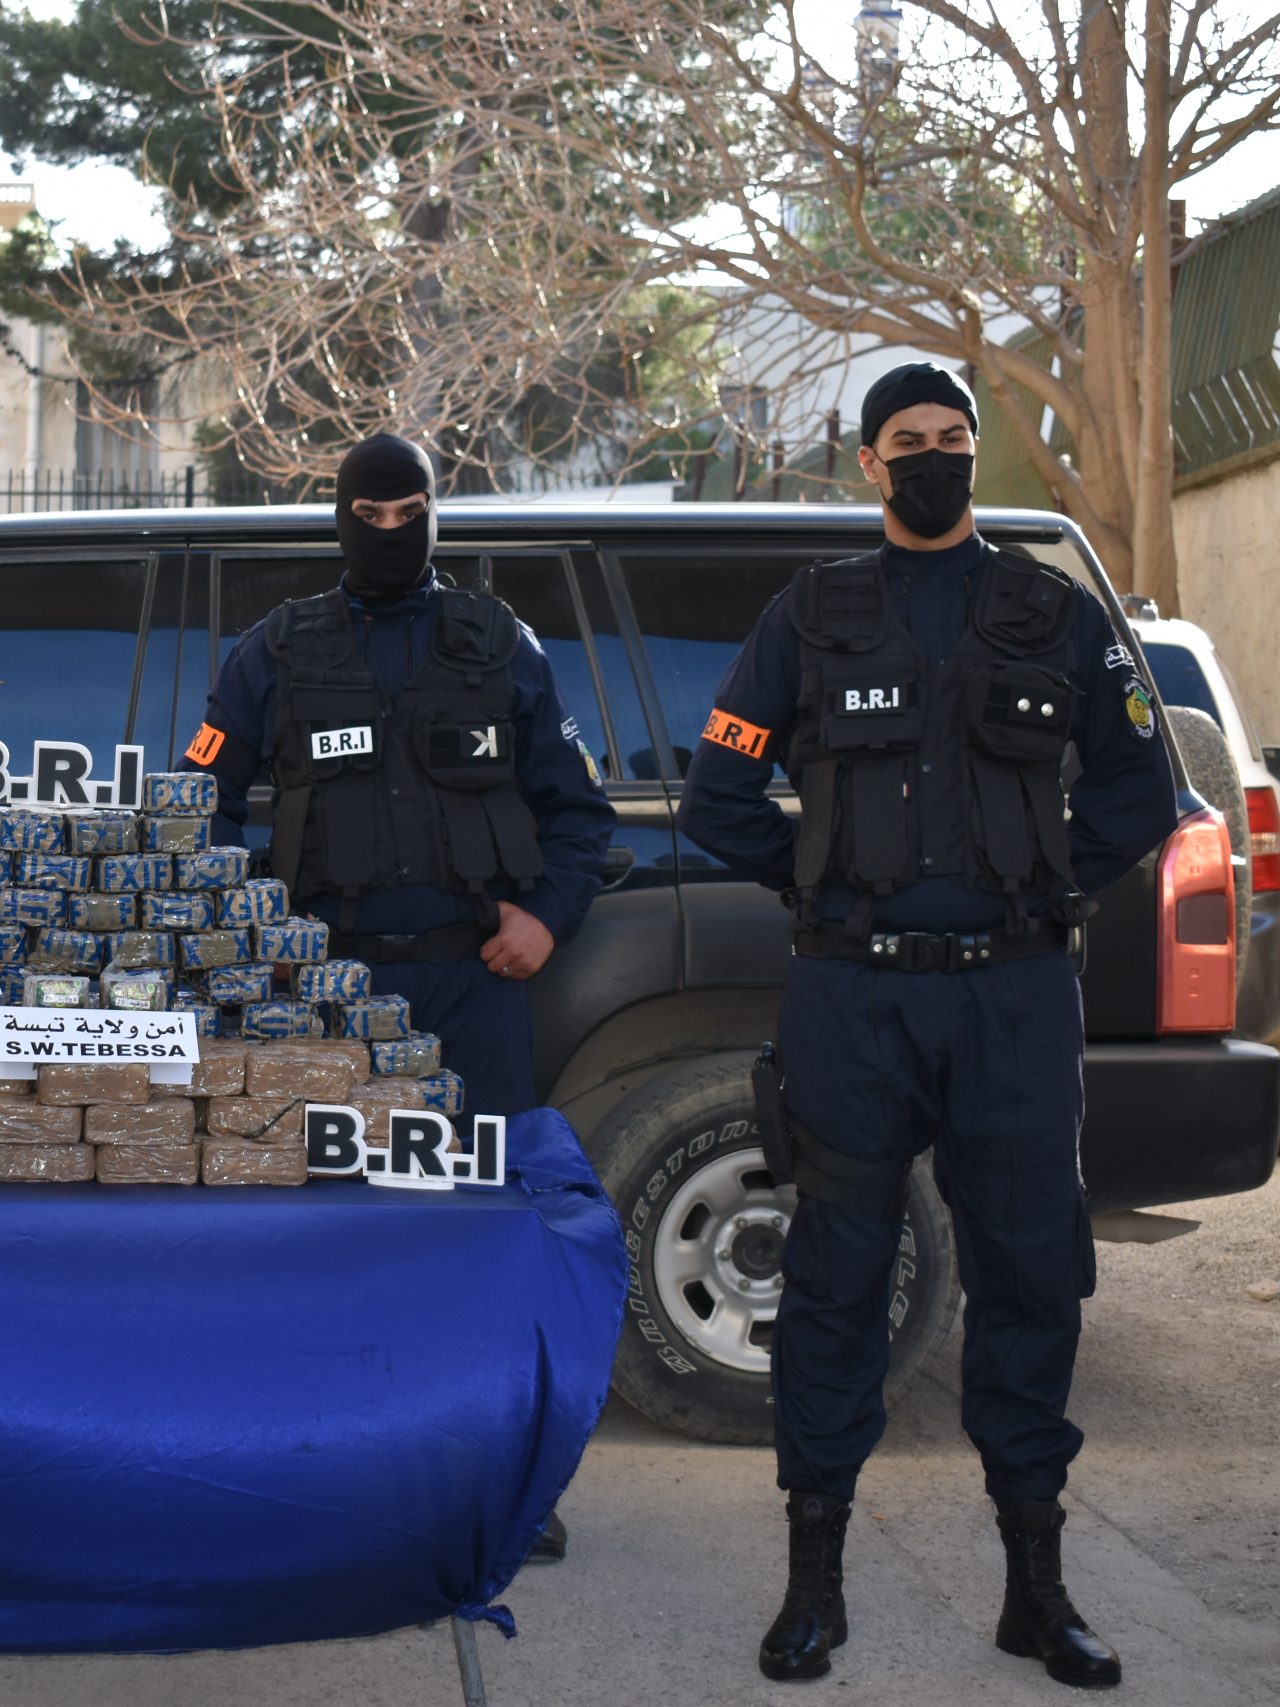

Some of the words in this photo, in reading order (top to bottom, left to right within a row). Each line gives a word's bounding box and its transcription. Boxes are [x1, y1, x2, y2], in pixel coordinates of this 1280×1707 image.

[845, 687, 899, 710] B.R.I
[319, 731, 366, 754] B.R.I
[705, 714, 762, 754] B.R.I
[4, 1014, 65, 1039] تبسة
[74, 1017, 139, 1039] ولاية
[145, 1016, 184, 1040] أمن
[6, 1040, 187, 1058] S.W.TEBESSA
[307, 1110, 497, 1180] B.R.I
